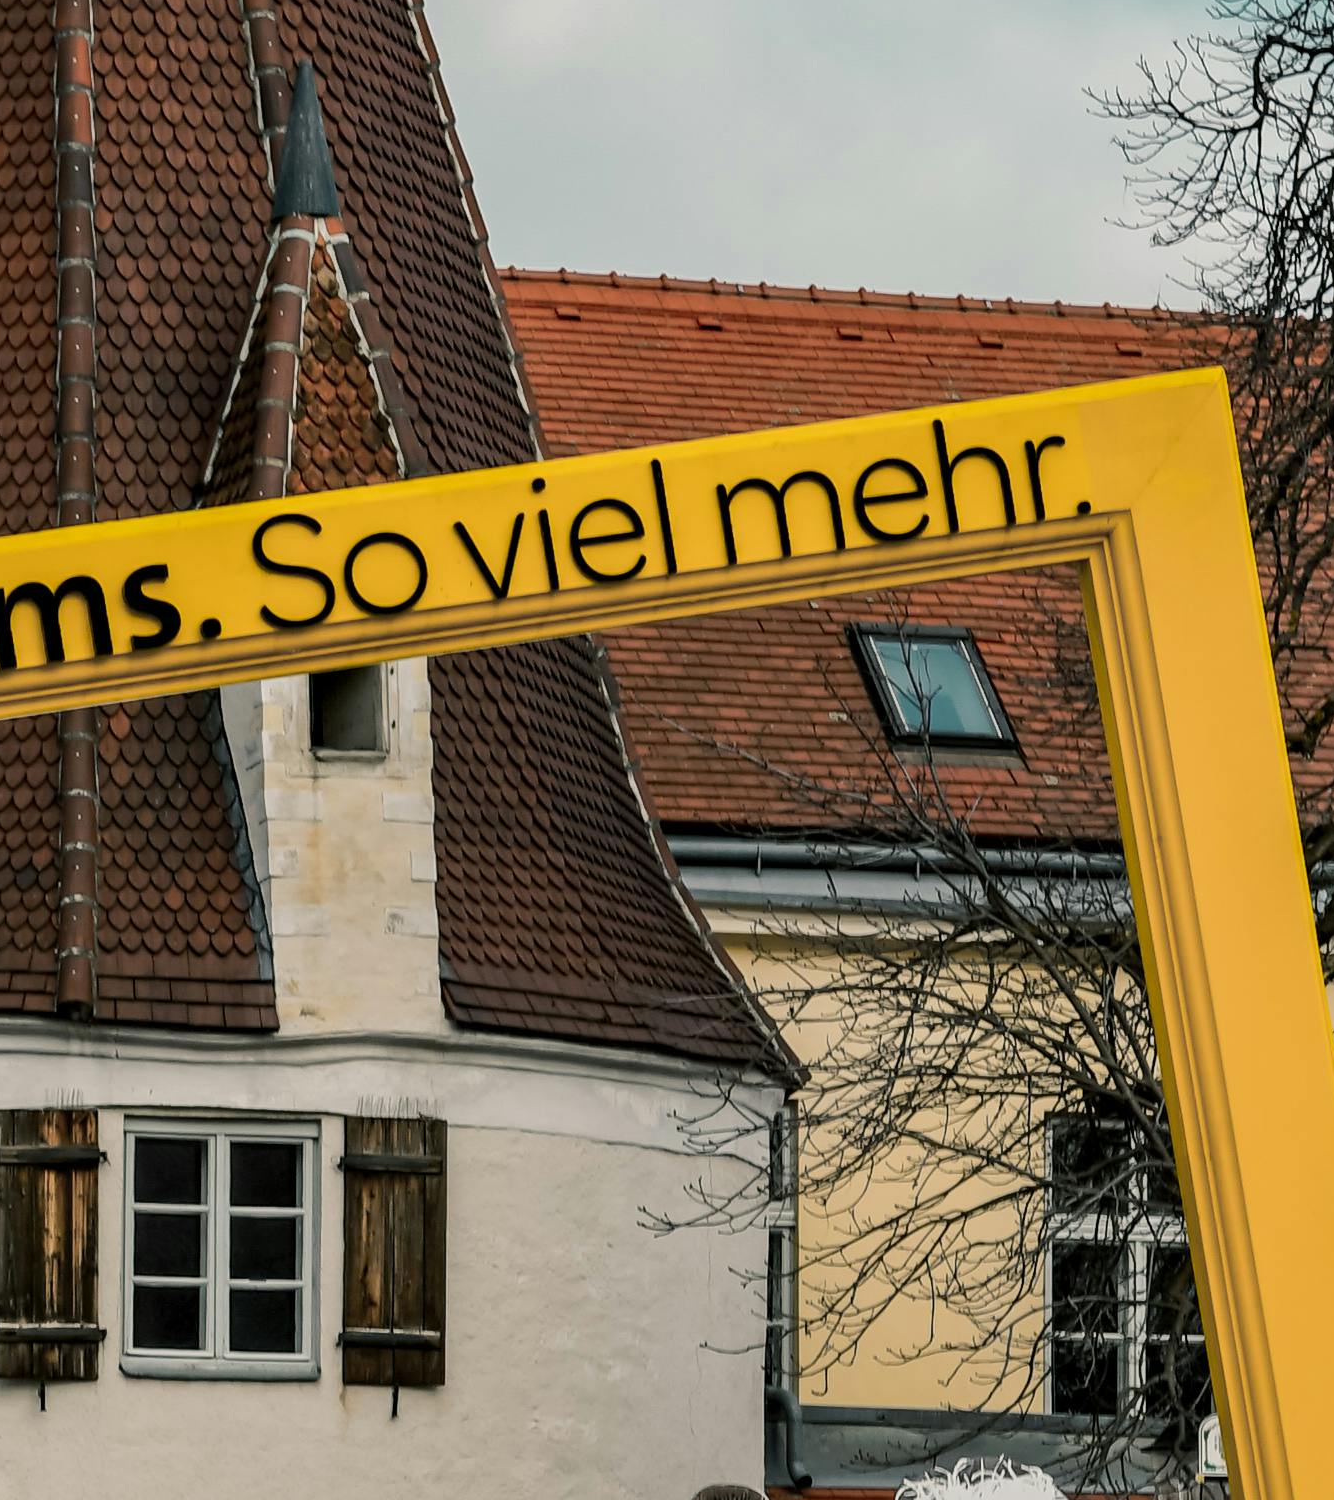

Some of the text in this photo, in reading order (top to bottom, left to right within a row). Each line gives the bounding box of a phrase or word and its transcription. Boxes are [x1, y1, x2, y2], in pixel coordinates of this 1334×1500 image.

[251, 513, 428, 629] So
[453, 459, 678, 599] viel
[715, 419, 1092, 566] mehr.
